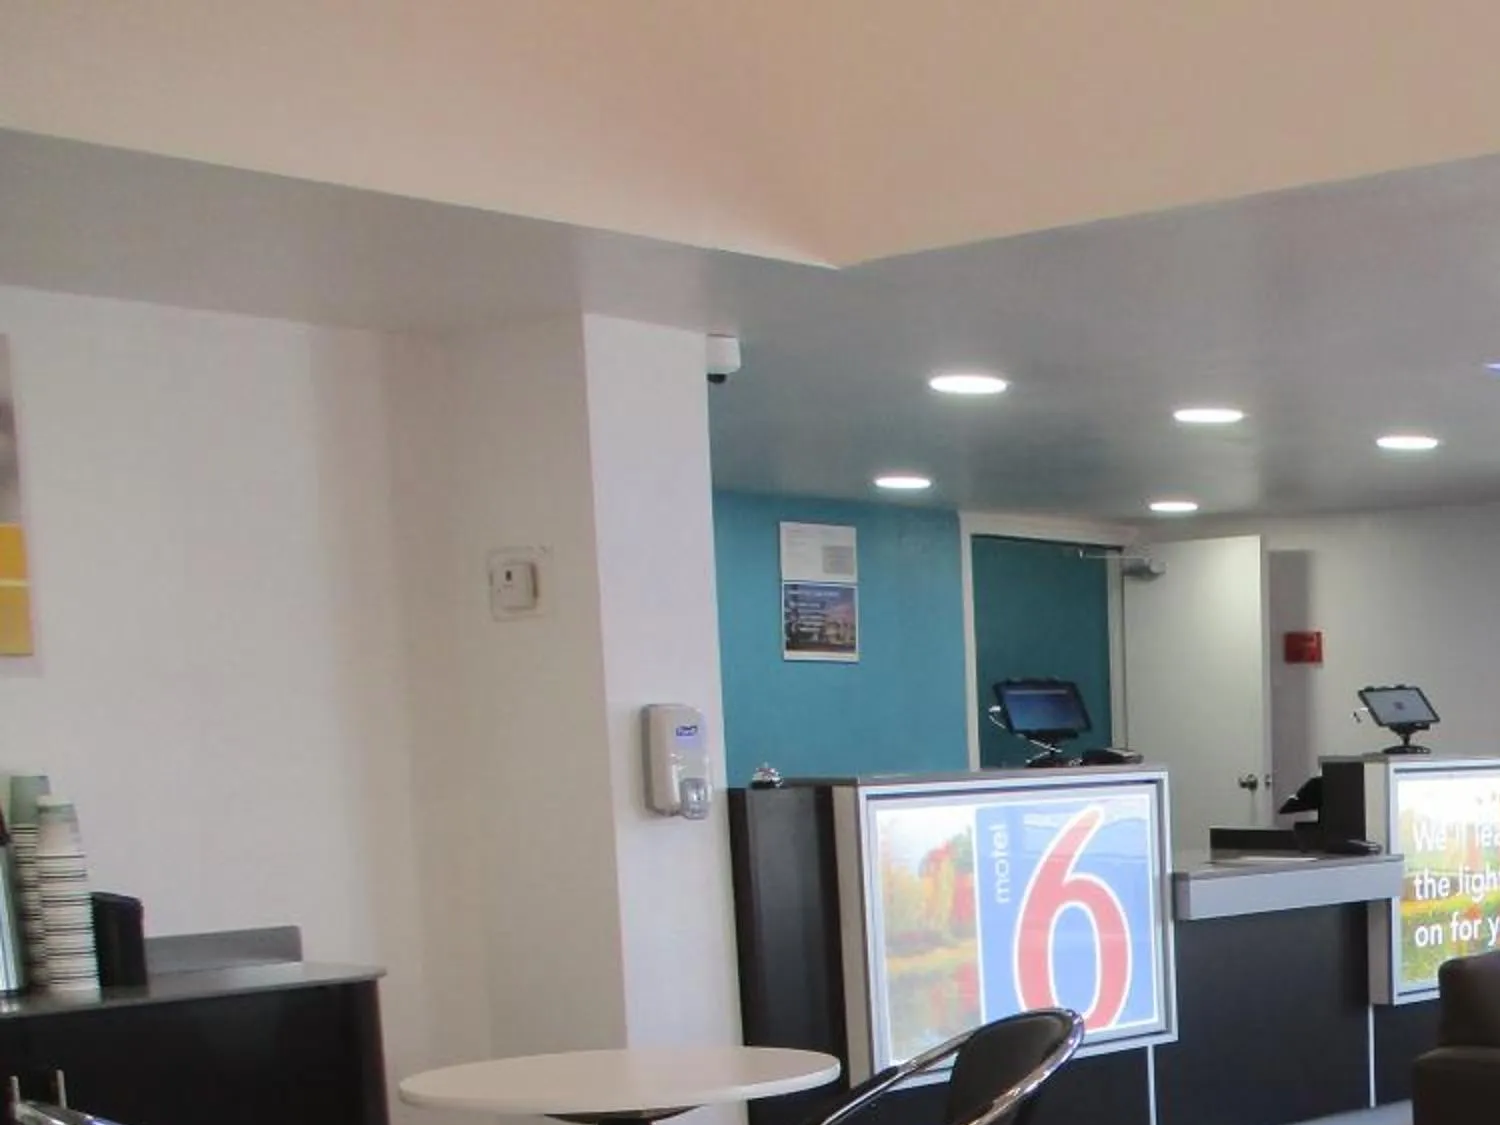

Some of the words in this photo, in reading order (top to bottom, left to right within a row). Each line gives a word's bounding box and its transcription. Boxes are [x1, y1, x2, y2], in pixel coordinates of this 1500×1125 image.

[1414, 867, 1451, 901] the
[989, 823, 1010, 904] motel
[1014, 805, 1133, 1034] 6
[1415, 923, 1443, 947] on
[1450, 911, 1482, 943] for
